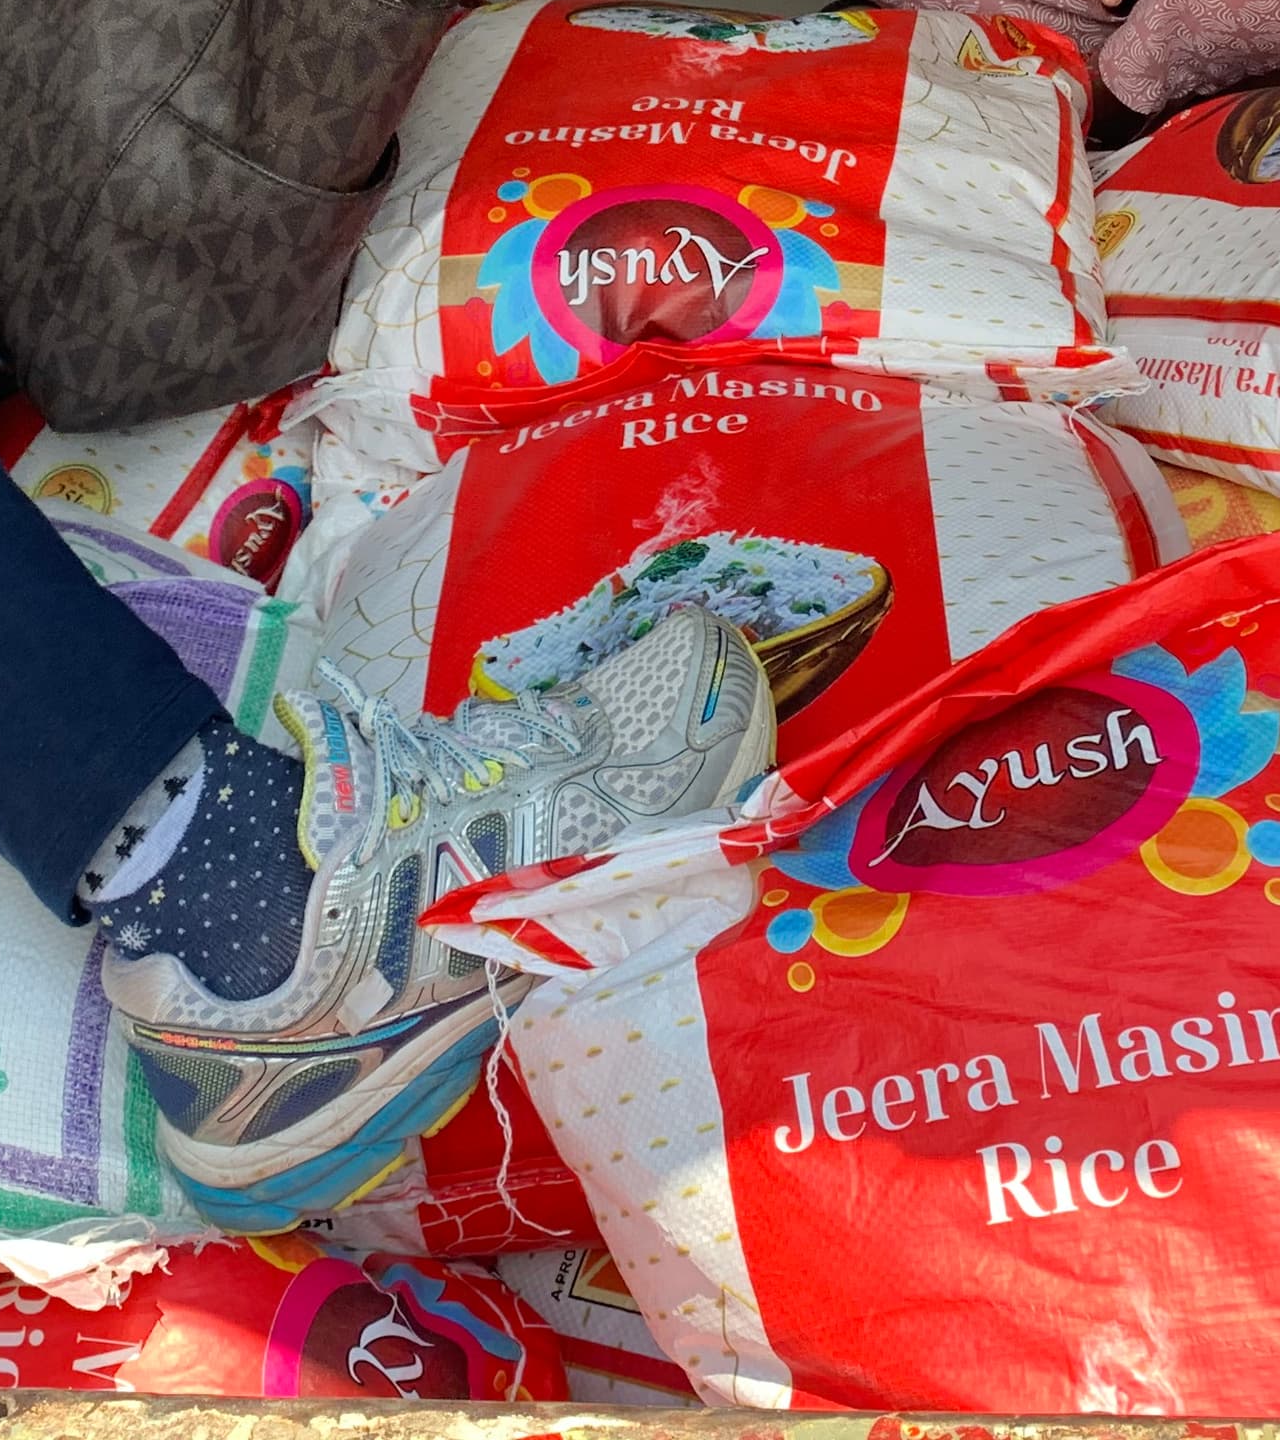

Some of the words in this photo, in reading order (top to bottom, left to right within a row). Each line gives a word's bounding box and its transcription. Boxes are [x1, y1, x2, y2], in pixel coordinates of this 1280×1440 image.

[504, 121, 703, 149] Masino
[631, 95, 745, 122] Rice
[709, 123, 859, 185] Jeera
[557, 226, 768, 306] Ayush
[499, 392, 656, 455] Jeera
[667, 372, 882, 413] Masino
[619, 408, 748, 452] Rice
[332, 765, 355, 812] new
[869, 708, 1162, 867] Ayush
[773, 1051, 1017, 1155] Jeera
[974, 1128, 1184, 1226] Rice
[554, 1249, 577, 1285] PRO
